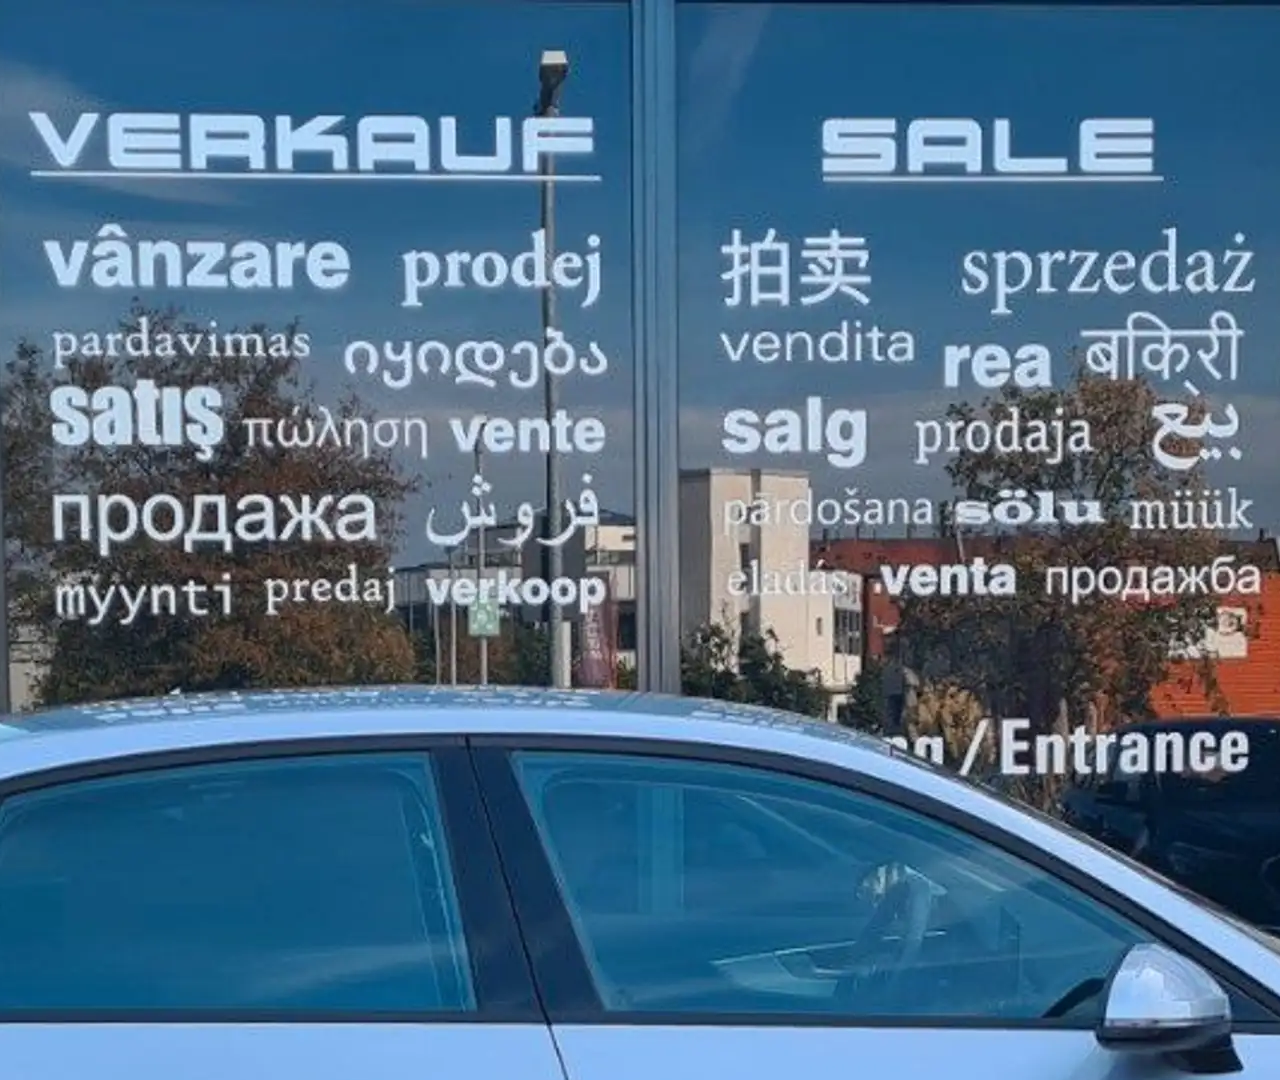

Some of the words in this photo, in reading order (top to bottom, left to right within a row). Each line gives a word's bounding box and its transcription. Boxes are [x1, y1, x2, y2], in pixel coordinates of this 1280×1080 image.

[28, 111, 594, 171] VERKAUF
[822, 118, 1154, 173] SALE
[43, 223, 350, 288] vânzare
[401, 230, 601, 307] prodej
[721, 229, 872, 306] 拍卖
[961, 228, 1255, 314] sprzedaż
[52, 317, 311, 369] pardavimas
[343, 326, 608, 388] იყიდება
[720, 321, 914, 363] vendita
[944, 344, 1052, 389] rea
[49, 379, 225, 460] satış
[241, 406, 428, 459] πώληση
[449, 410, 606, 453] vente
[721, 397, 868, 468] salg
[915, 409, 1093, 465] prodaja
[1151, 403, 1242, 470] بيع
[52, 493, 378, 557] продажа
[723, 487, 933, 535] pārdošana
[955, 489, 1105, 525] sölu
[1130, 488, 1254, 530] müük
[55, 573, 232, 626] myynti
[265, 562, 395, 612] predaj
[425, 569, 607, 614] verkoop
[727, 559, 848, 597] eladás
[879, 557, 1017, 595] venta
[1045, 556, 1261, 603] продажба
[1001, 718, 1249, 774] Entrance
